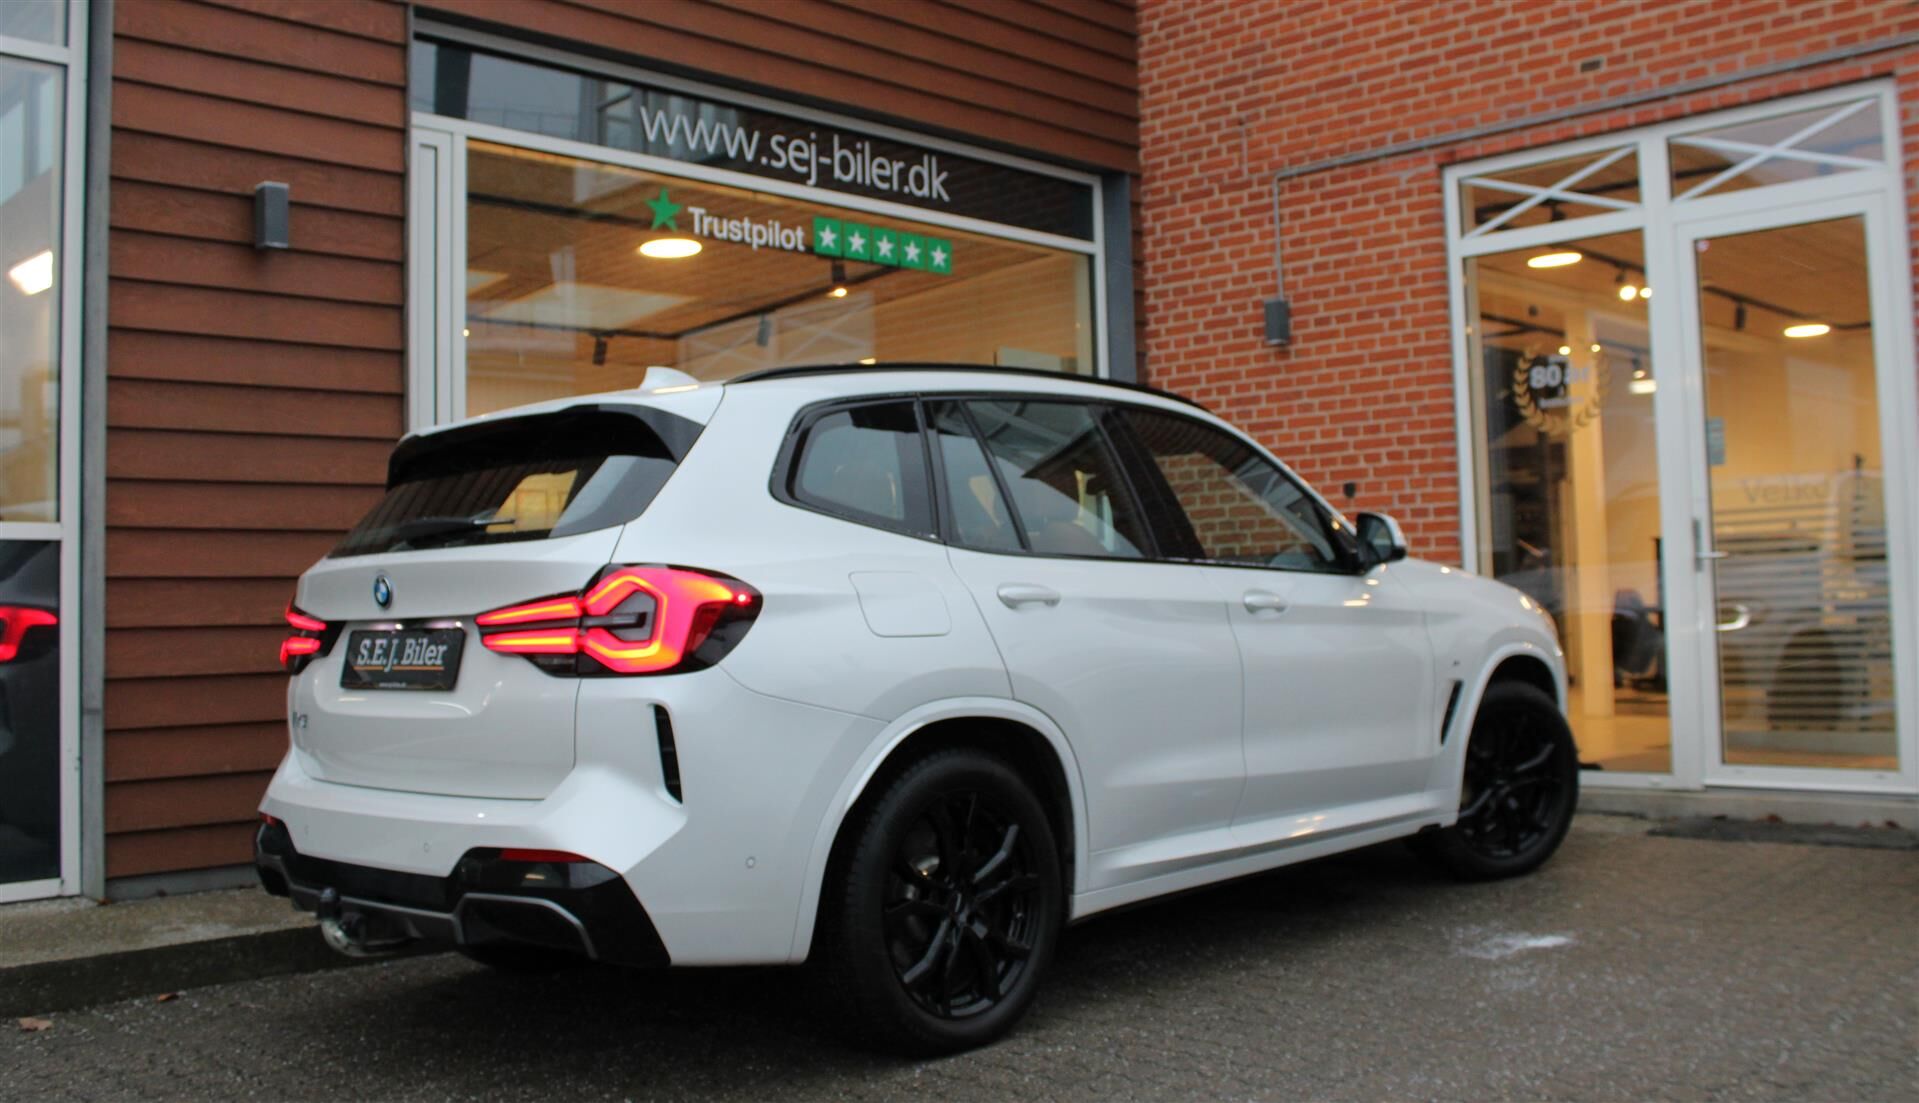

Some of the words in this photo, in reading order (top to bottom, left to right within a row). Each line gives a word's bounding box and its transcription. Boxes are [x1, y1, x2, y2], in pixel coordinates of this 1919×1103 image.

[640, 106, 949, 201] www.sej-biler.dk
[687, 206, 805, 251] Trustpilot
[1529, 364, 1562, 389] 80
[357, 638, 398, 672] S.E.J.
[401, 638, 447, 665] Biler
